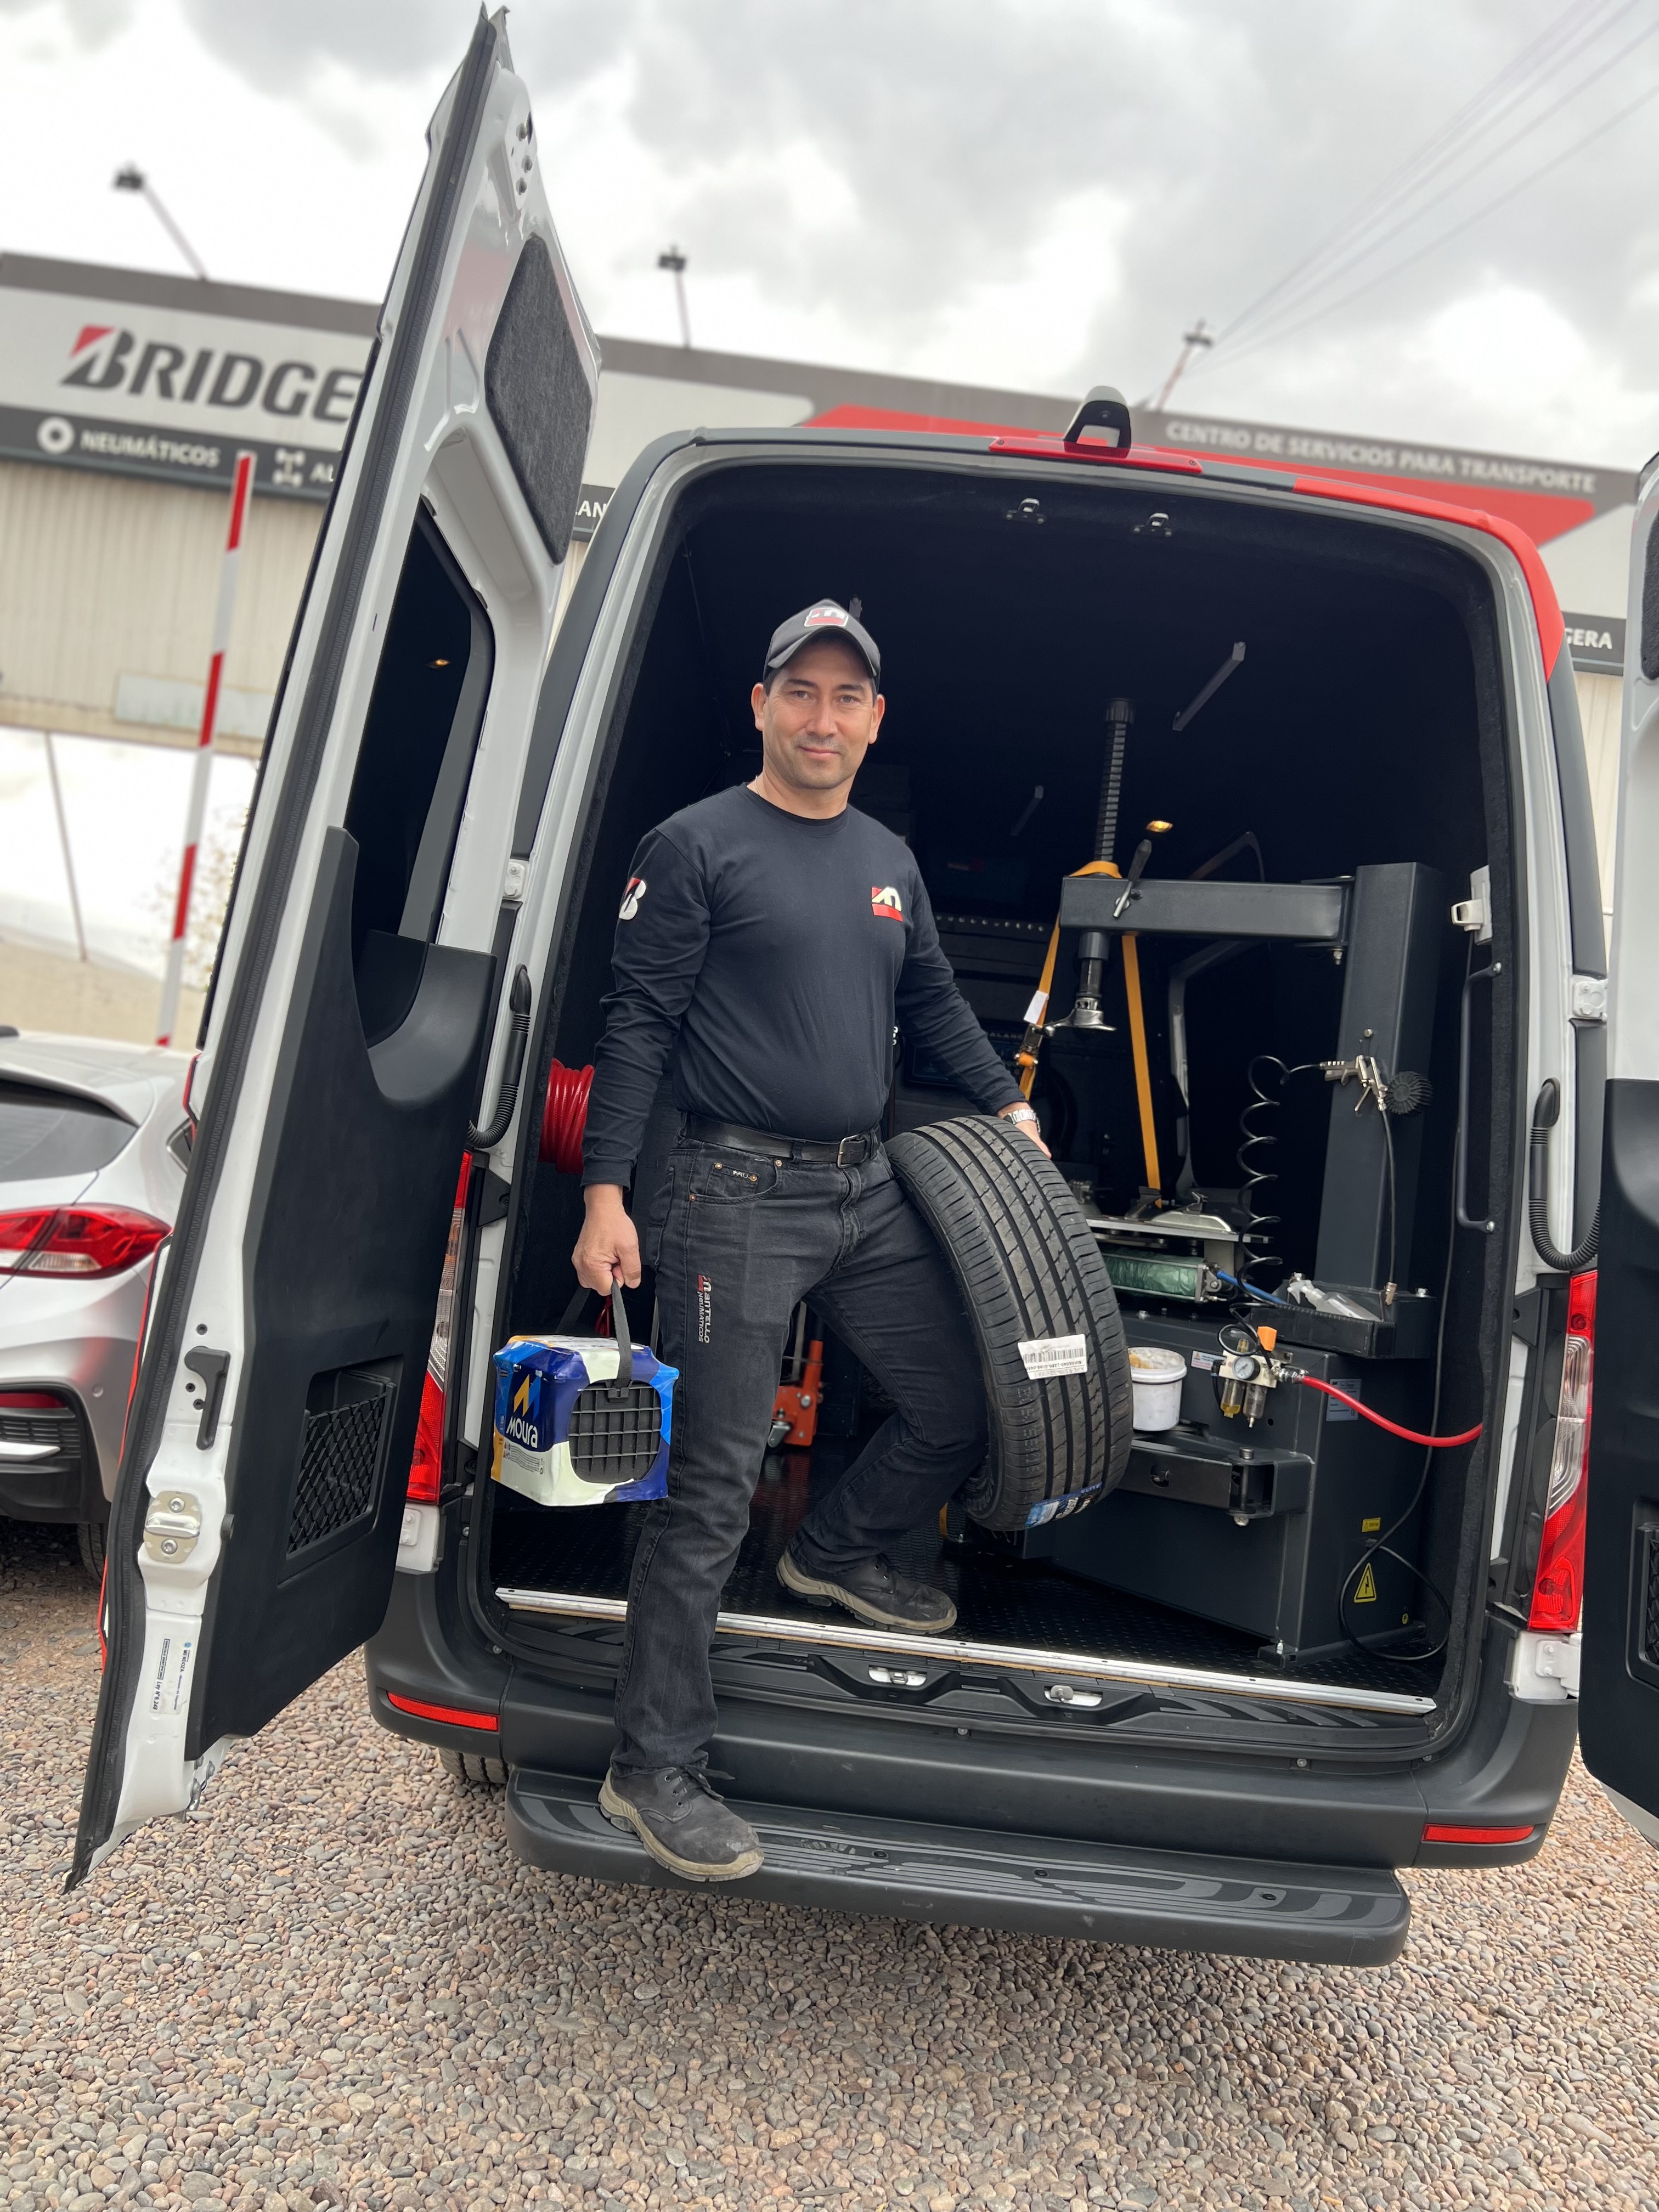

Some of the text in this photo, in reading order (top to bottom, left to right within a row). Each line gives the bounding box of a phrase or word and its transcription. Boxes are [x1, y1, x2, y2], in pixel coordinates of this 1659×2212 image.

[59, 324, 365, 425] BRIDGE
[80, 428, 221, 469] NEUMÁTICOS
[1165, 420, 1598, 493] CENTRO DE SERVICIOS PARA TRANSPORTE
[575, 500, 607, 518] AN
